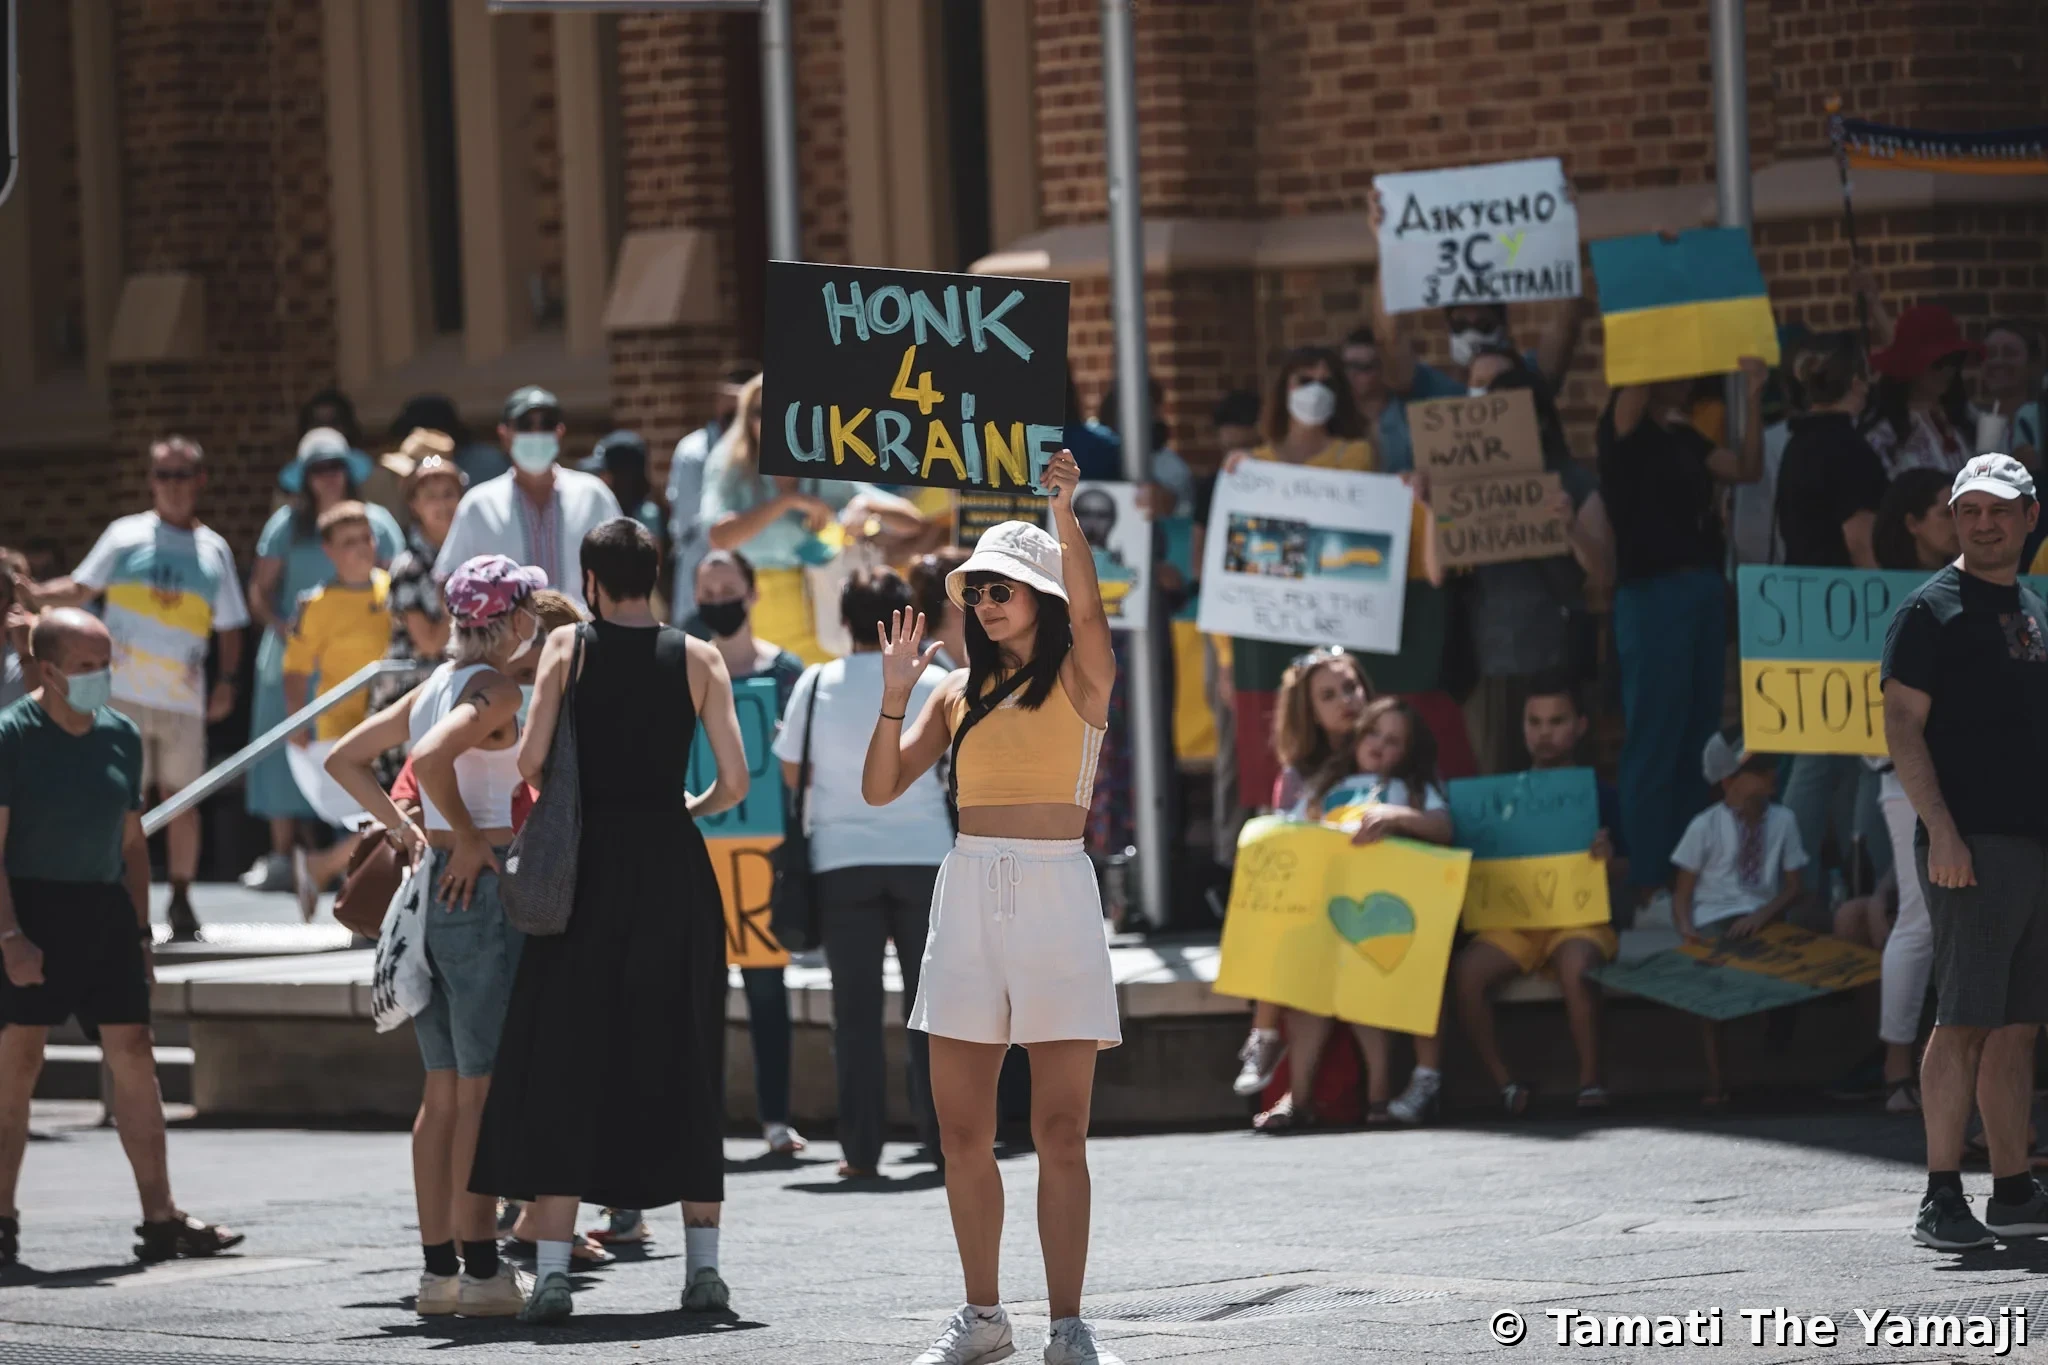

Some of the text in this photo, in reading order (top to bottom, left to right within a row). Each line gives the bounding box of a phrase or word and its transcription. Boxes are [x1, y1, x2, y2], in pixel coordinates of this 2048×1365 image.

[1436, 229, 1526, 276] ЗСУ
[822, 280, 1034, 363] HONK
[890, 344, 944, 415] 4
[1423, 398, 1510, 433] STOP
[1428, 436, 1512, 467] WAR
[1447, 479, 1544, 519] STAND
[1442, 519, 1563, 556] UKRAINE
[1758, 573, 1890, 647] STOP
